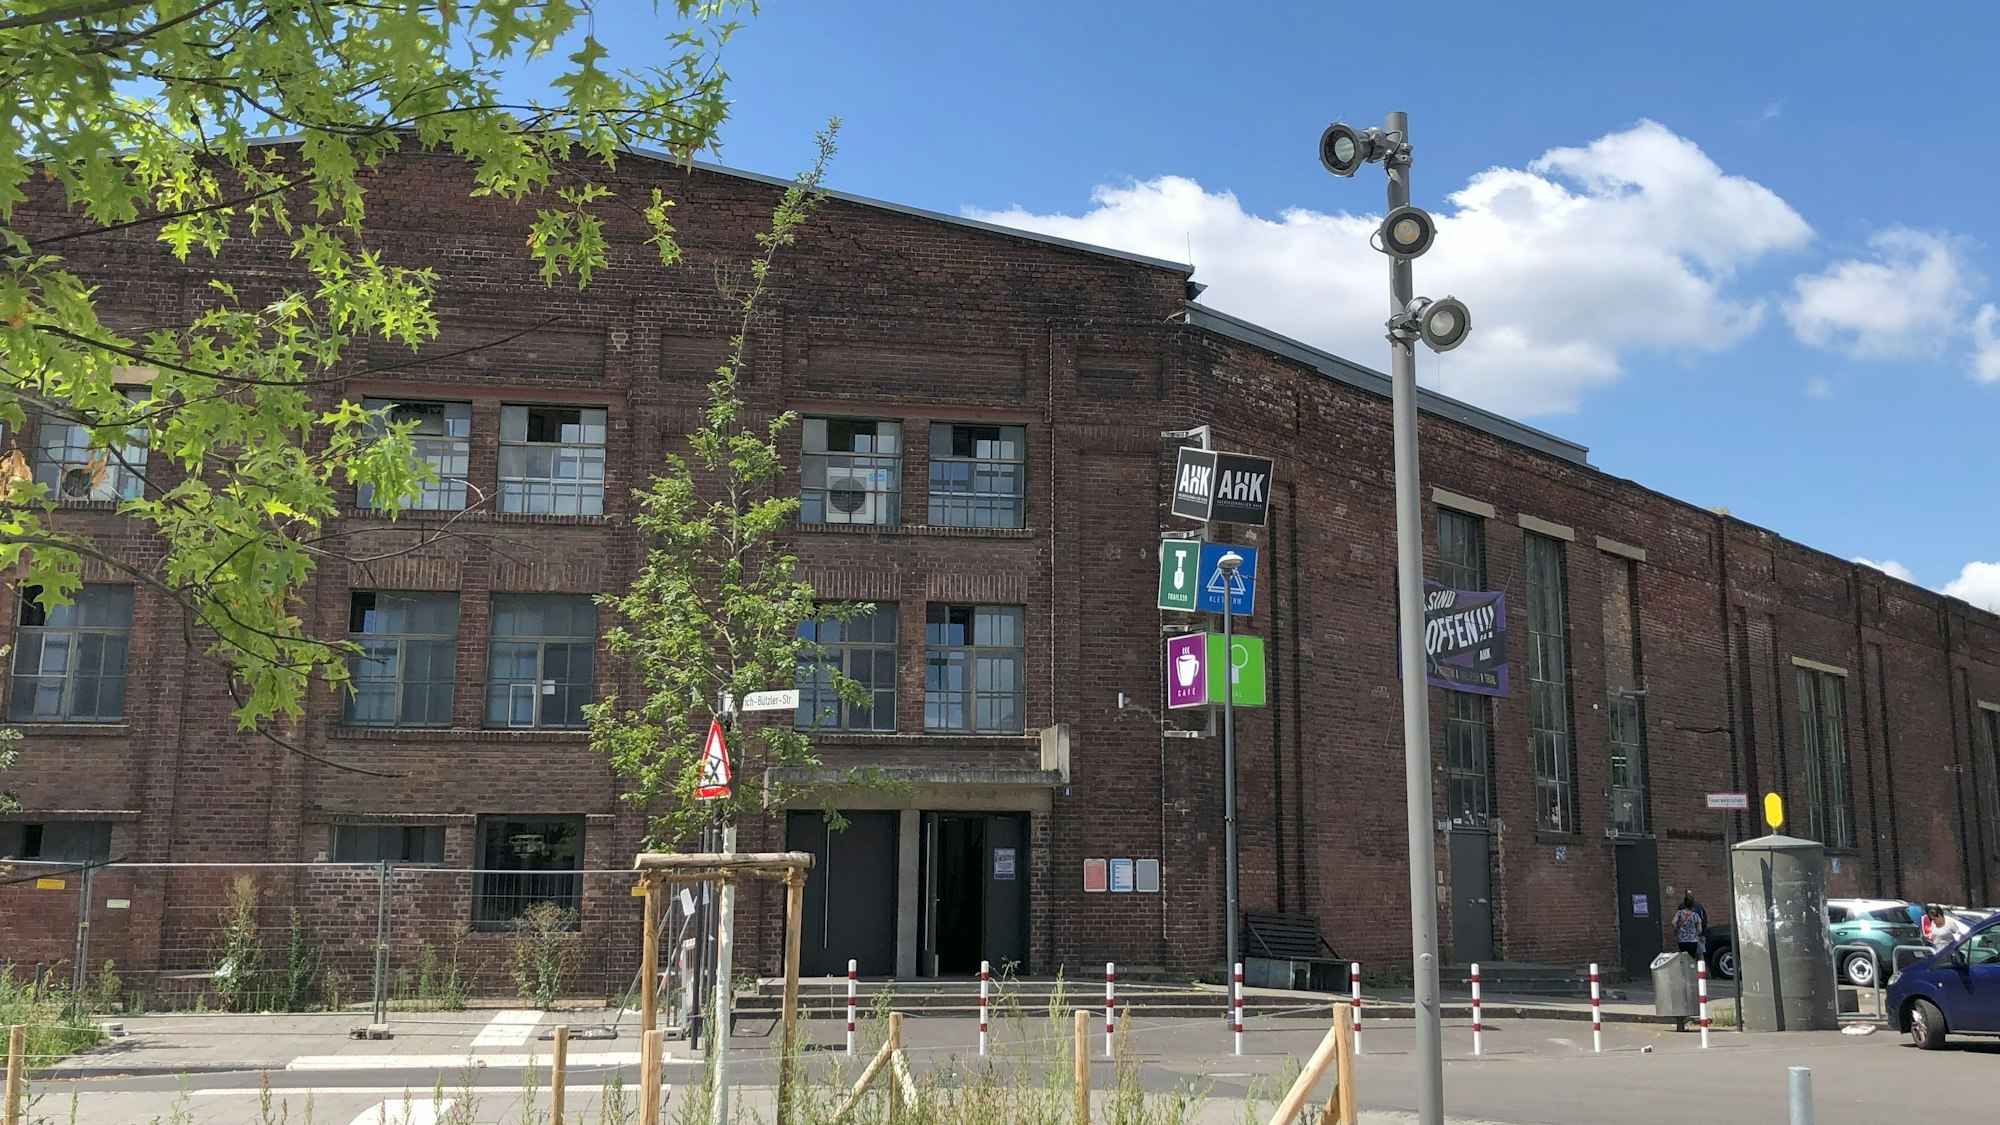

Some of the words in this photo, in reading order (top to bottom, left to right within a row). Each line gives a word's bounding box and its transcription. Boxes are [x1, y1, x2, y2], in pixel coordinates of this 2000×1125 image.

[1179, 464, 1211, 497] AHK
[1217, 470, 1265, 503] AHK
[1428, 590, 1456, 611] SIND
[1425, 605, 1494, 655] OFFEN!!!
[744, 694, 794, 707] ich-Bützler-Str.
